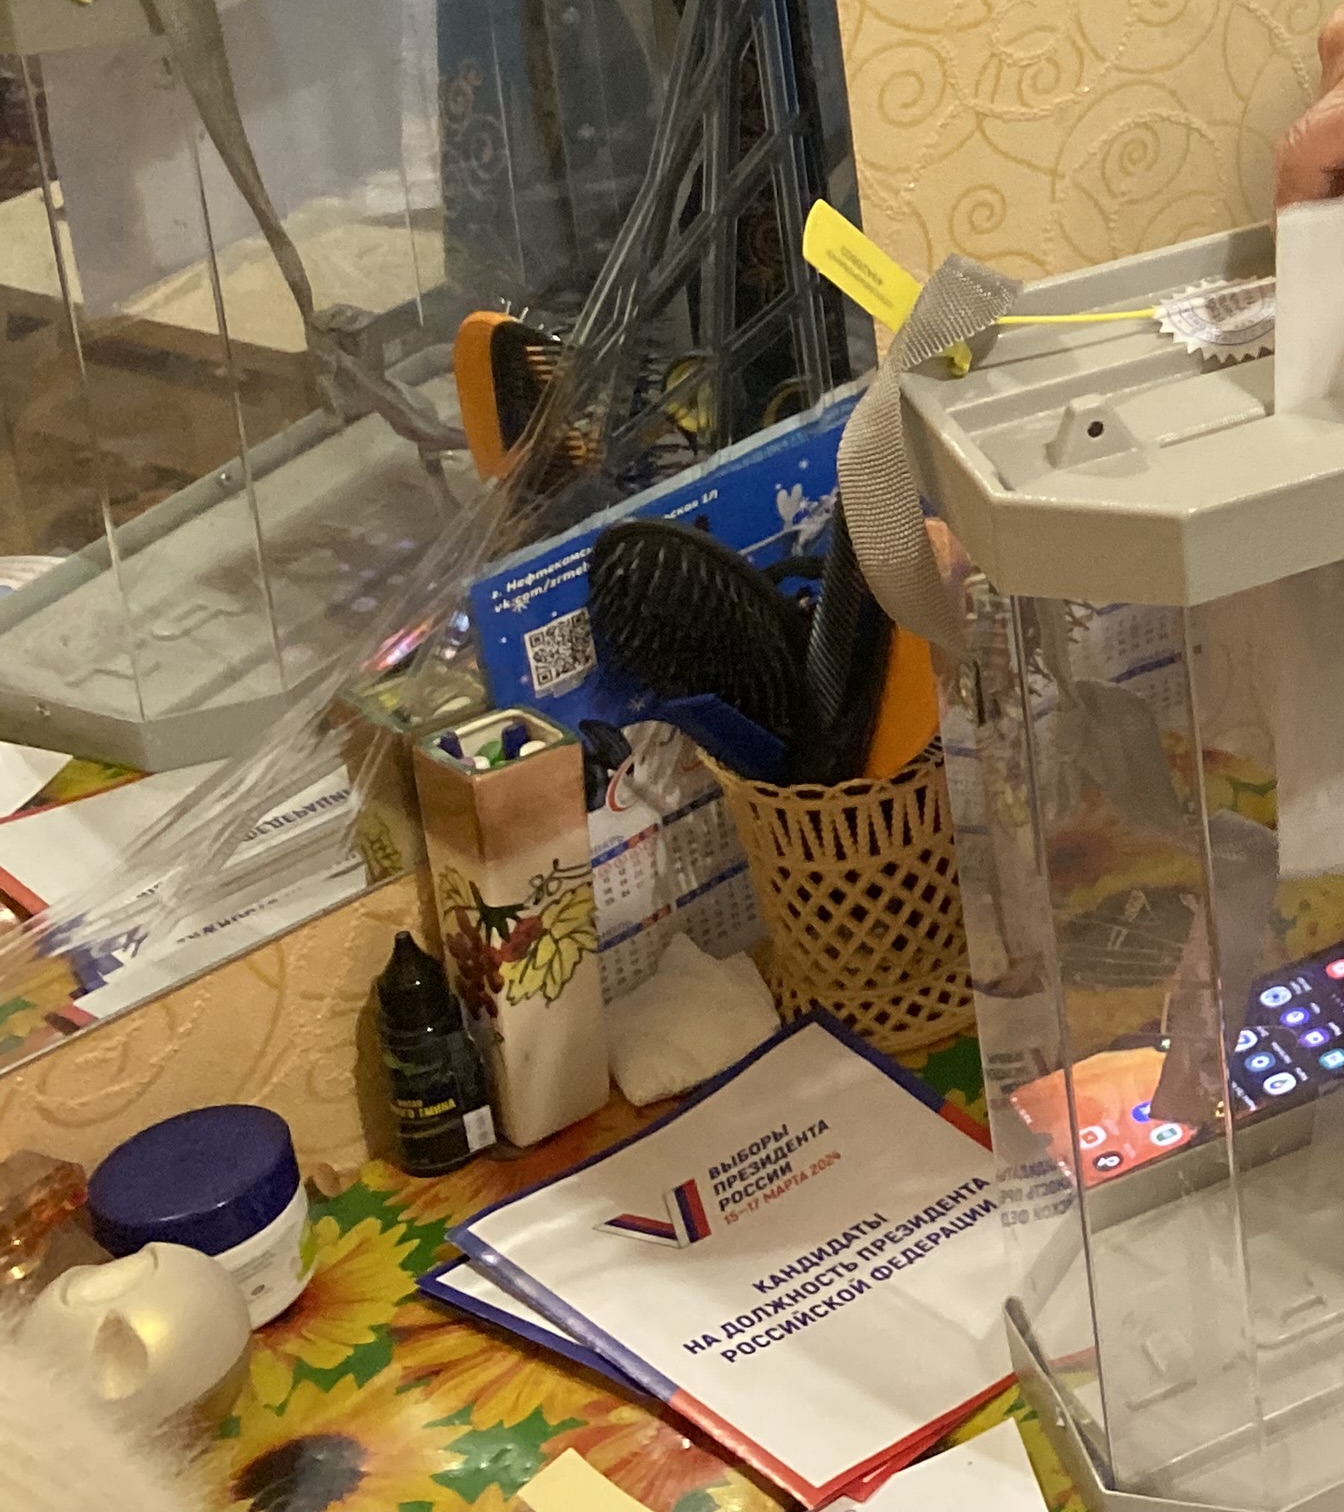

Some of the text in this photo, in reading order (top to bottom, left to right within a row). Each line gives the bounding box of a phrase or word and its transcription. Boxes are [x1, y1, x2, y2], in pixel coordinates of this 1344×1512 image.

[706, 1123, 789, 1181] ВЫБОРЫ
[711, 1118, 829, 1196] ПРЕЗИДЕНТА
[716, 1160, 793, 1212] РОССИИ
[761, 1169, 809, 1204] МАРТА
[682, 1173, 991, 1357] НА ДОЛЖНОСТЬ ПРЕЗИДЕНТА
[719, 1196, 998, 1366] РОССИЙСКОЙ ФЕДЕРАЦИИ
[751, 1209, 888, 1297] КАНДИДАТЫ
